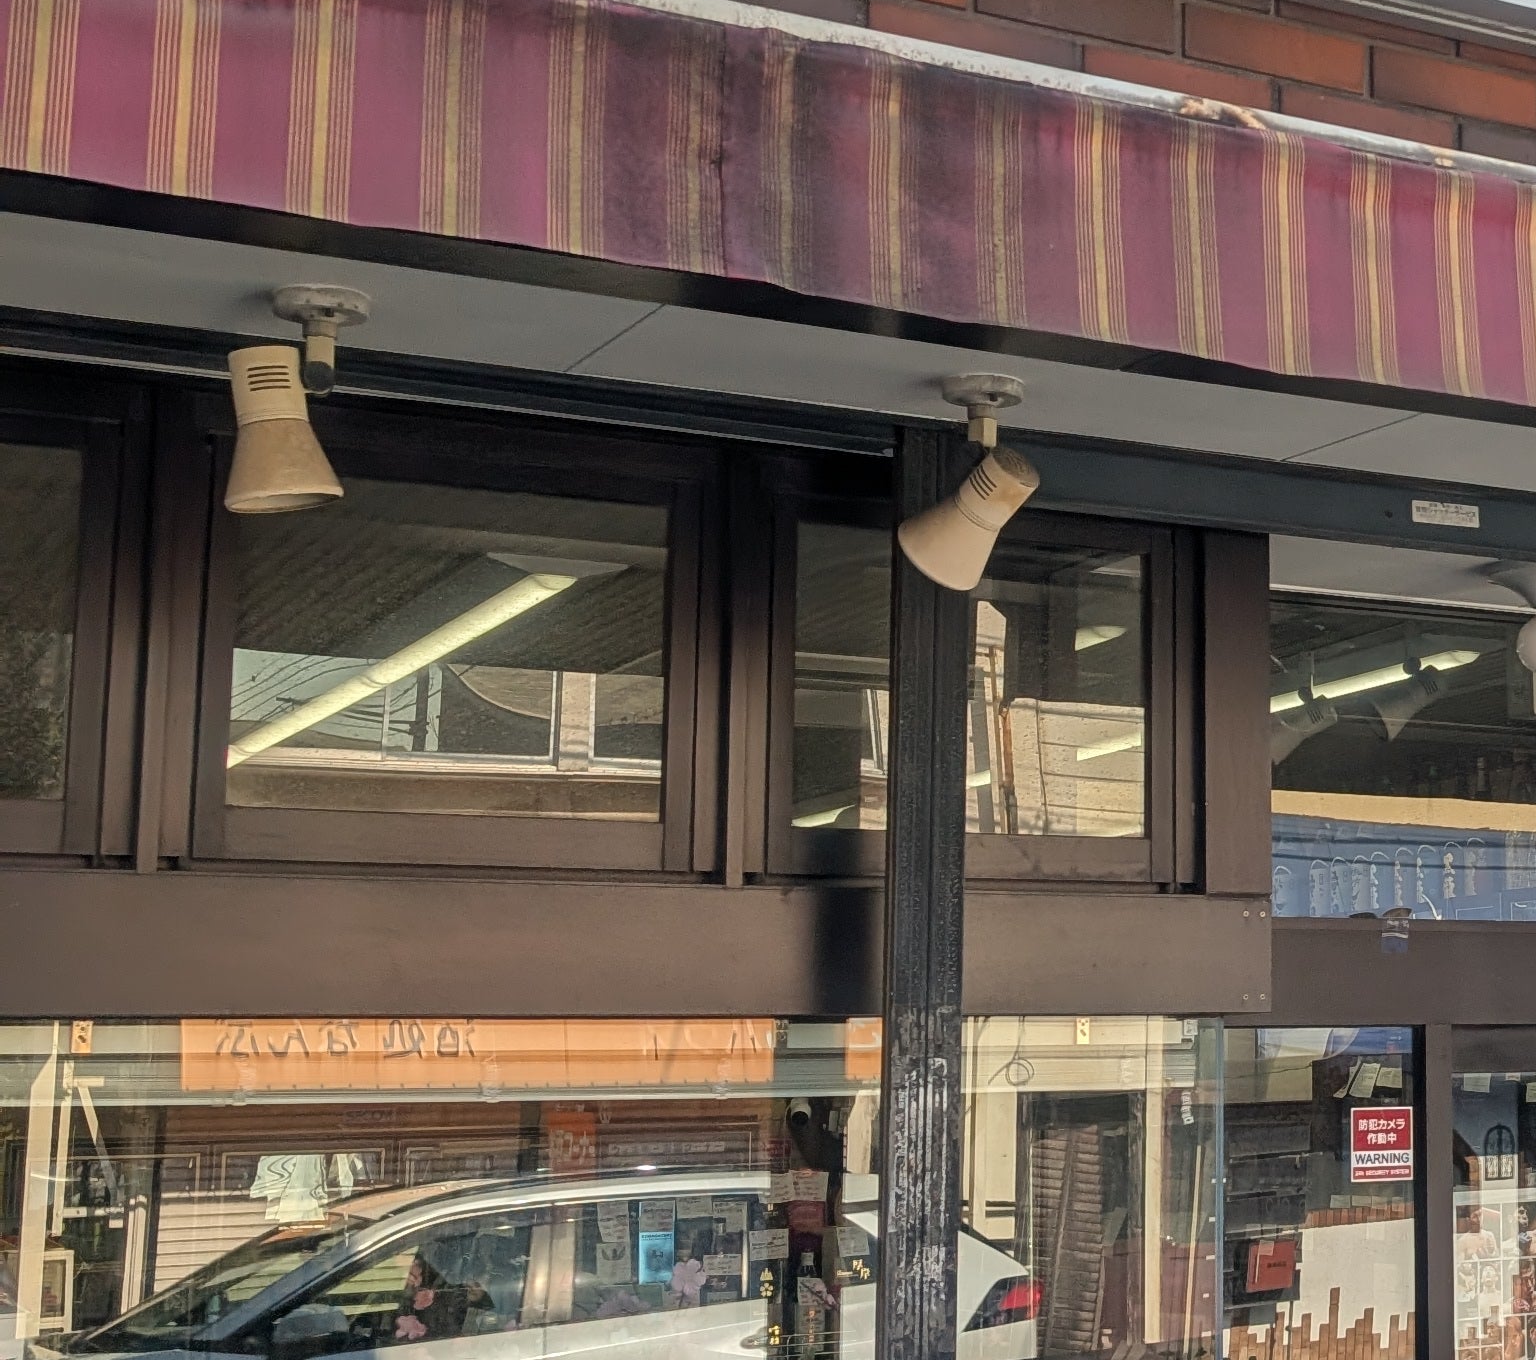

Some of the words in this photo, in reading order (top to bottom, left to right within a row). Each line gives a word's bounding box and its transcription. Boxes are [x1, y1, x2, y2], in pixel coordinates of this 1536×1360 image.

[1358, 1118, 1406, 1131] 防犯カメラ
[1367, 1132, 1397, 1144] 作動中
[1354, 1152, 1410, 1165] WARNING
